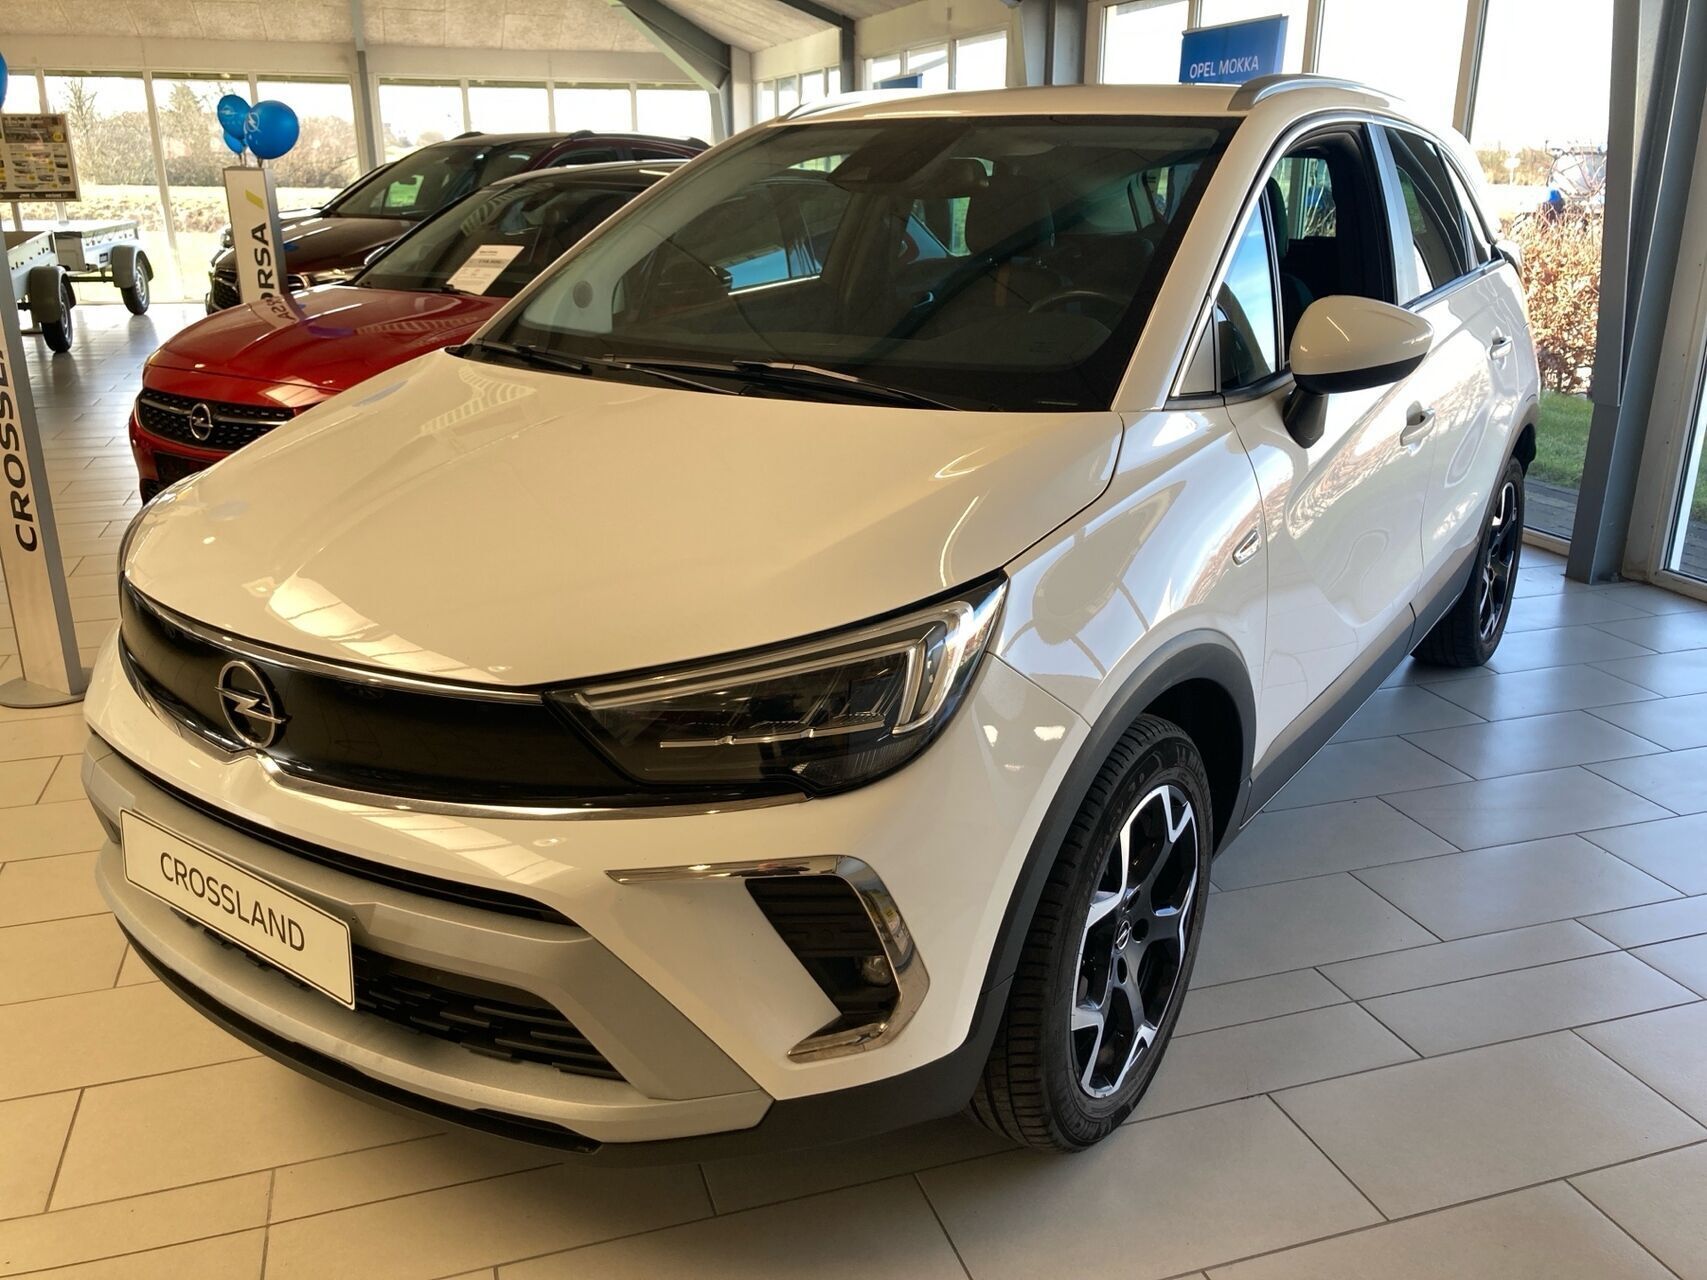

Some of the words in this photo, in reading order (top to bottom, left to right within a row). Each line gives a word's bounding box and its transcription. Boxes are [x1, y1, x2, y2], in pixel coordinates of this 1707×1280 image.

[1190, 62, 1216, 79] OPEL
[1219, 55, 1259, 75] MOKKA
[0, 350, 38, 552] CROSSL
[160, 852, 305, 952] CROSSLAND
